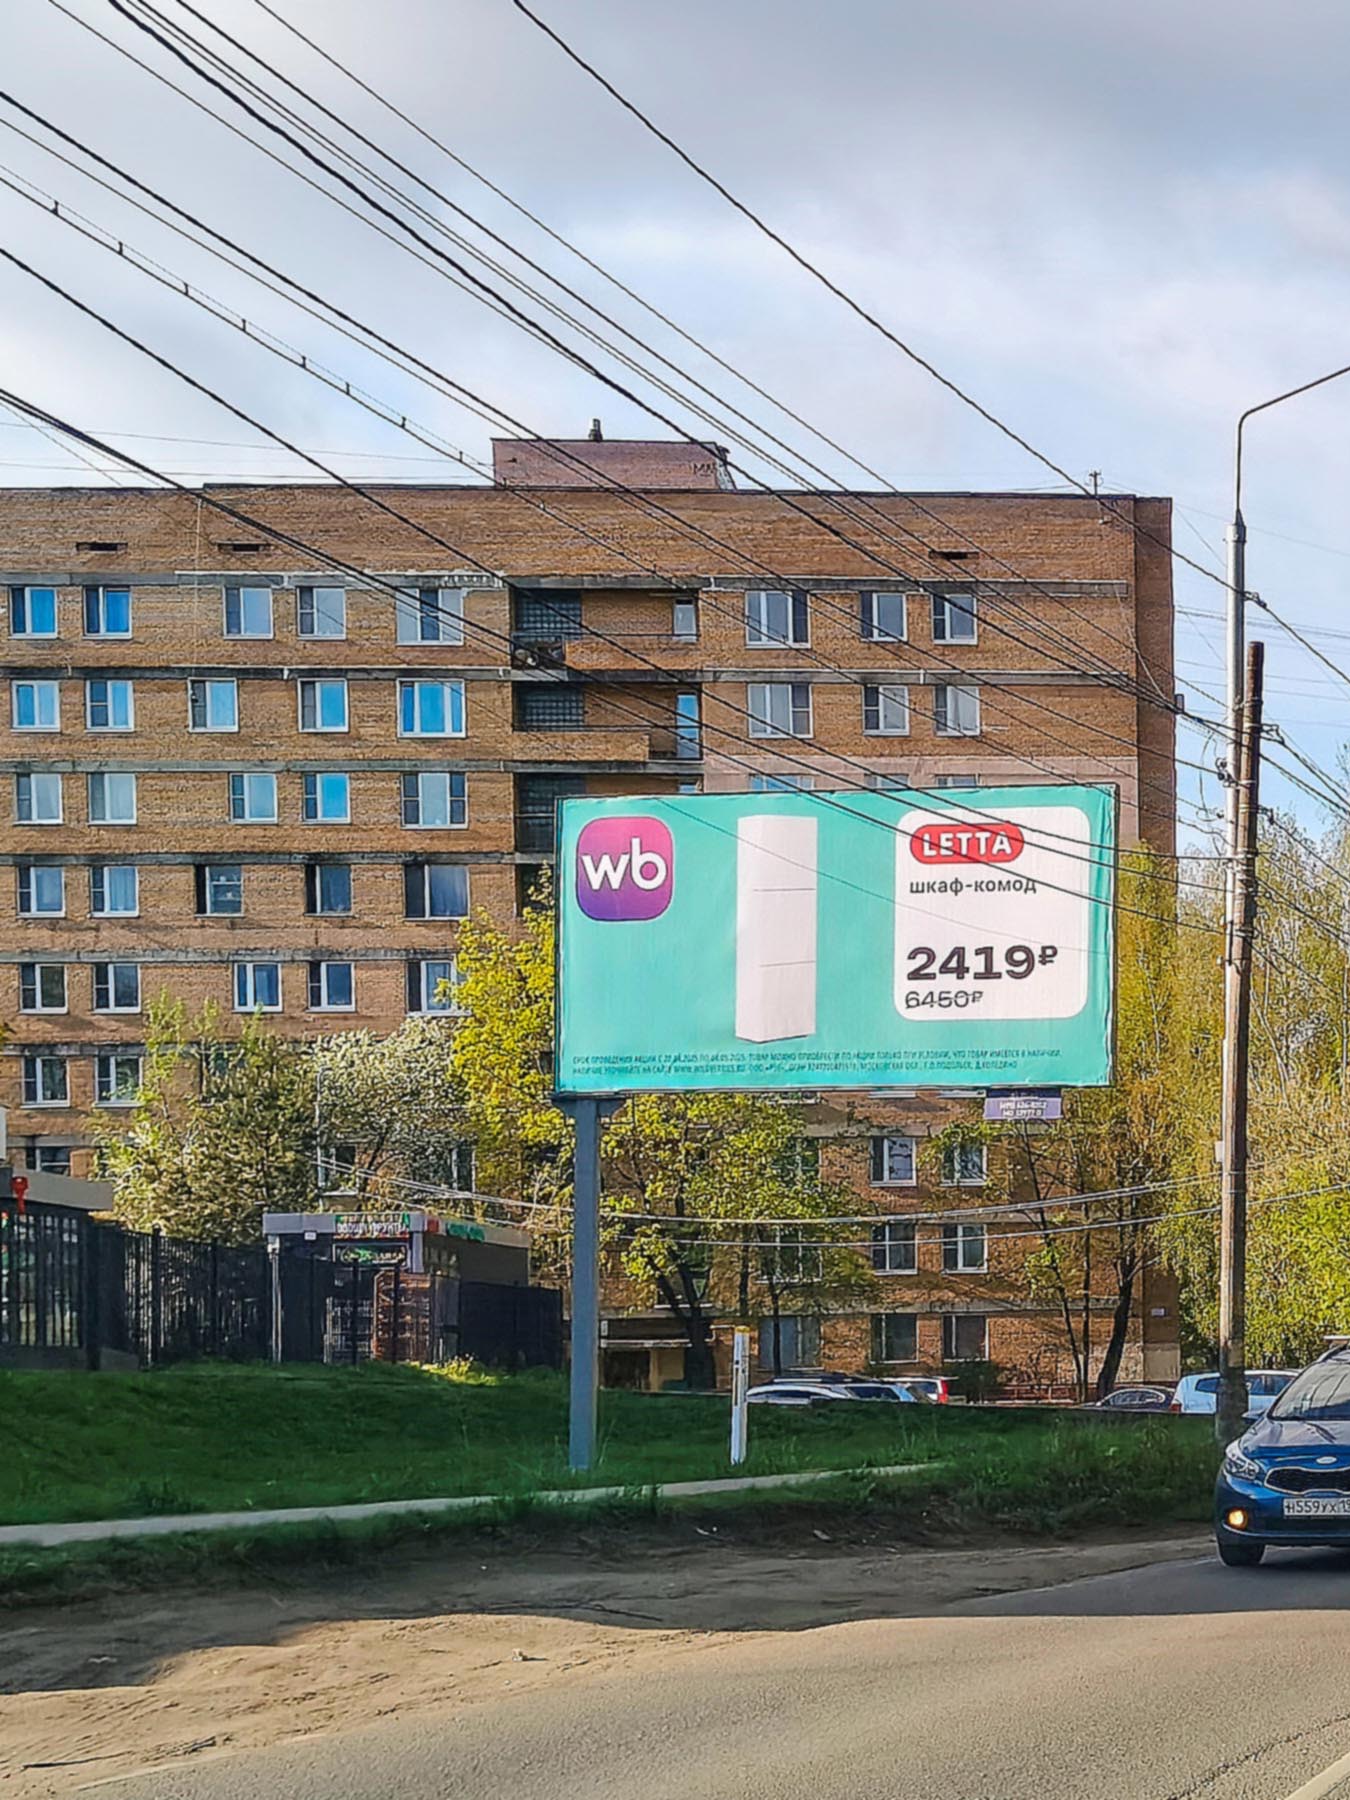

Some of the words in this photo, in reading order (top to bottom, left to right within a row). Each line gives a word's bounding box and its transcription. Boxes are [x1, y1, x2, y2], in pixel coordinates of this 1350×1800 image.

[922, 831, 1013, 857] LETTA
[581, 837, 668, 891] wb
[909, 877, 1037, 896] шкаф-комод
